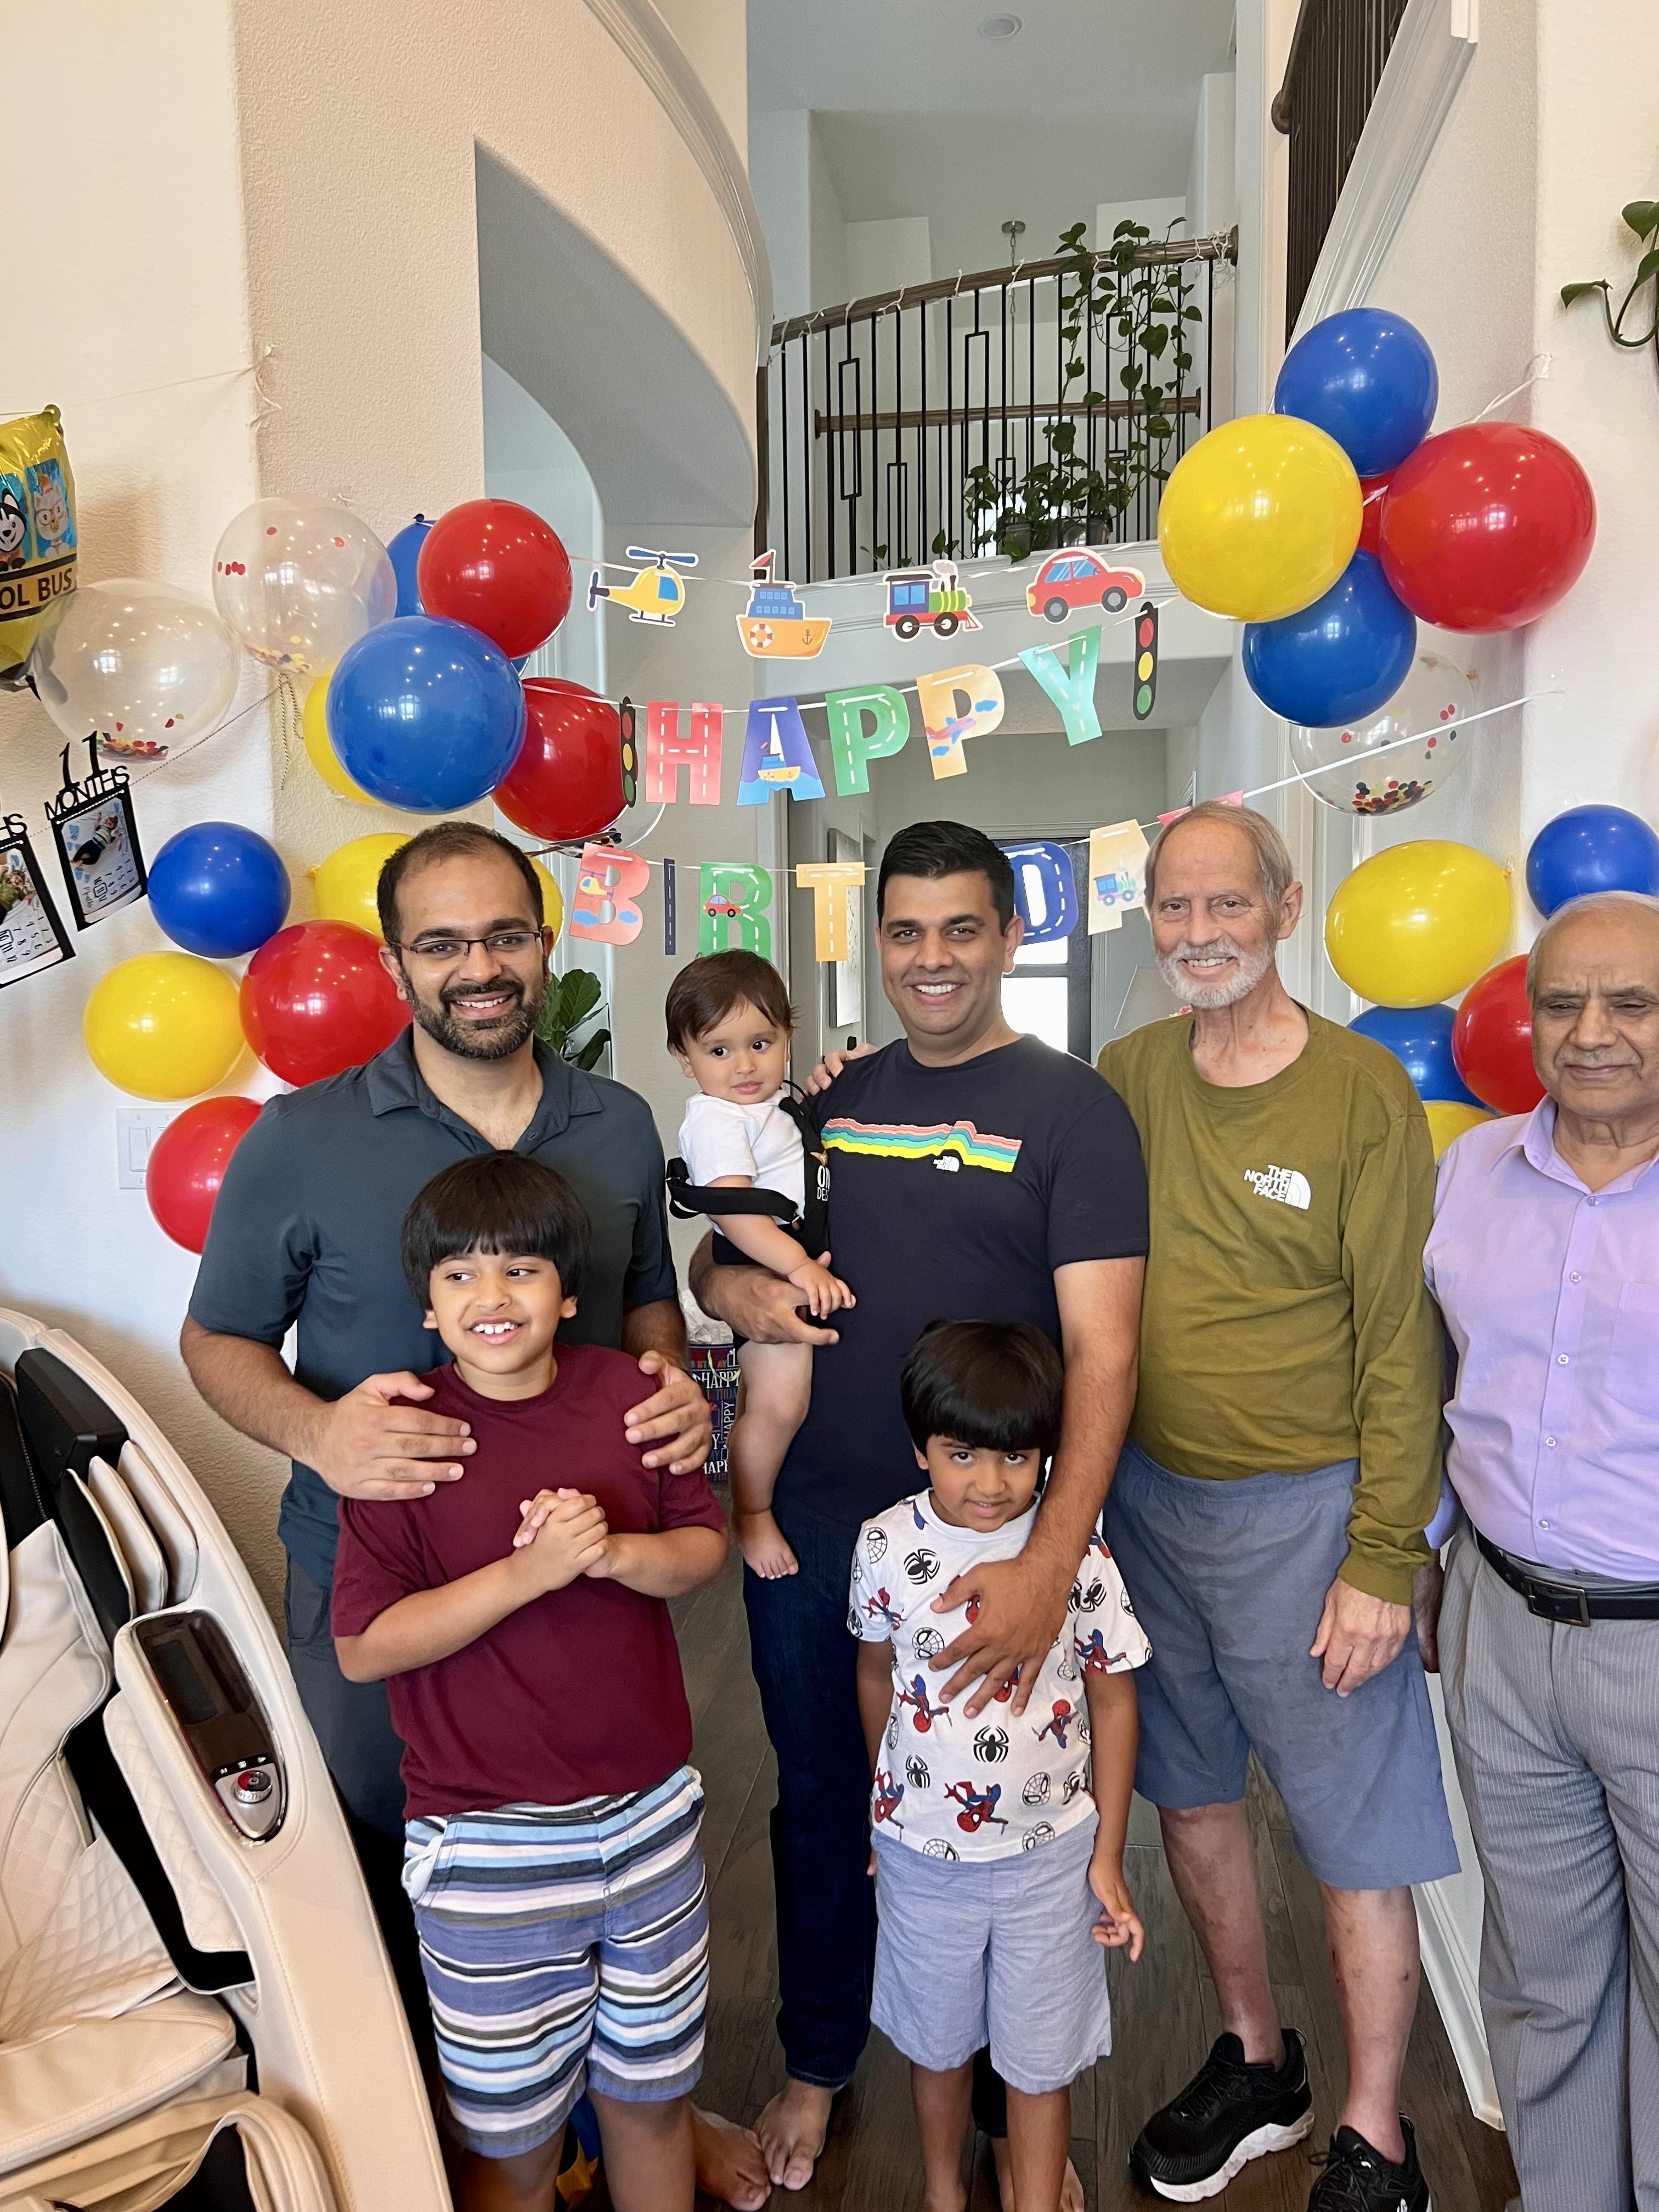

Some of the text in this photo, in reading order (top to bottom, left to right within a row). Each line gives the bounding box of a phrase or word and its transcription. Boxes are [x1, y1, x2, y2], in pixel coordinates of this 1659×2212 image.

[38, 568, 72, 601] BUS
[645, 624, 1103, 805] HAPPY
[59, 730, 109, 792] 11
[569, 790, 1244, 962] BIRTDA
[1244, 1169, 1290, 1194] NORTH
[1267, 1164, 1293, 1180] THE
[1253, 1182, 1286, 1202] FACE
